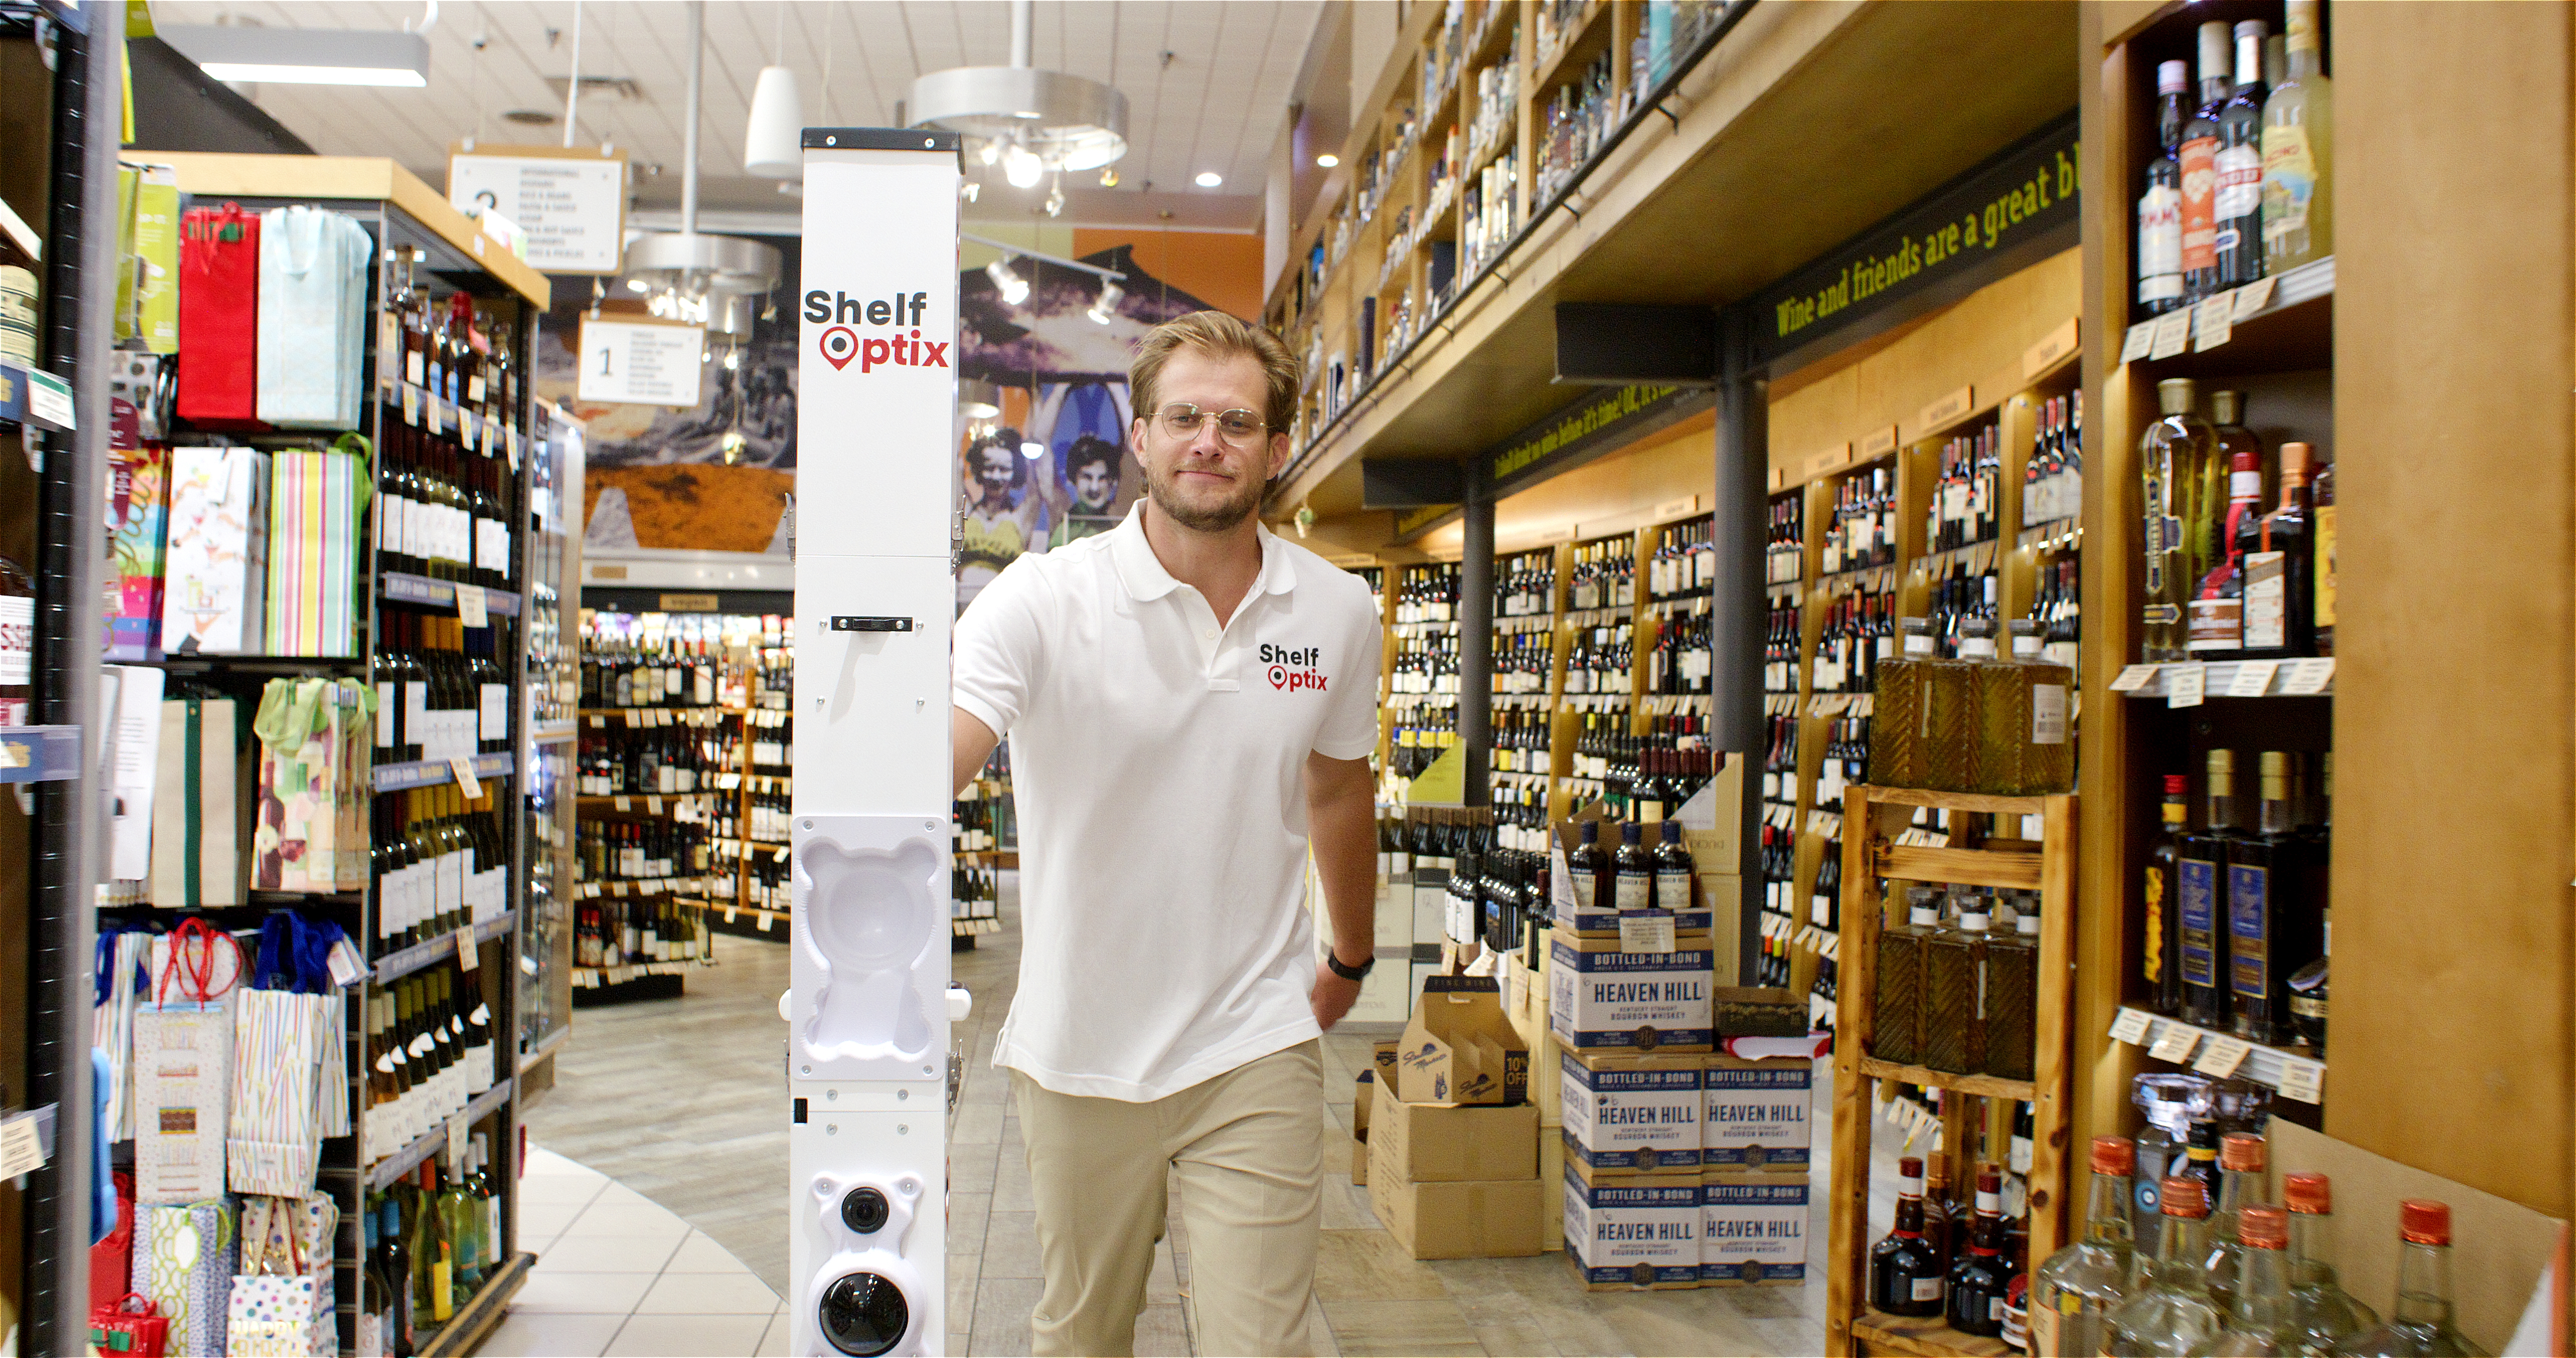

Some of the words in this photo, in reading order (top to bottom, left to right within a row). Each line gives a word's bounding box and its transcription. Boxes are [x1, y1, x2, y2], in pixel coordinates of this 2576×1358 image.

[1776, 296, 1815, 338] Wine
[1817, 267, 1848, 318] and
[1853, 235, 1921, 302] friends
[1925, 222, 1960, 267] are
[1964, 212, 1979, 248] a
[1983, 165, 2051, 250] great
[804, 290, 927, 326] Shelf
[820, 326, 949, 373] Optix
[598, 347, 613, 377] 1
[1259, 644, 1319, 666] Shelf
[1268, 665, 1328, 693] Optix
[1594, 952, 1701, 966] BOTTLED-IN-BOND
[1594, 982, 1659, 1003] HEAVEN
[1664, 980, 1703, 1001] HILL
[1598, 1072, 1695, 1084] BOTTLED-IN-BOND
[1599, 1107, 1656, 1125] HEAVEN
[1661, 1106, 1696, 1124] HILL
[1709, 1105, 1766, 1122] HEAVEN
[1770, 1104, 1805, 1122] HILL
[1597, 1189, 1693, 1201] BOTTLED-IN-BOND
[1597, 1223, 1654, 1241] HEAVEN
[1659, 1222, 1694, 1240] HILL
[1707, 1220, 1763, 1238] HEAVEN
[1768, 1220, 1801, 1237] HILL
[235, 1320, 301, 1338] HAPPY
